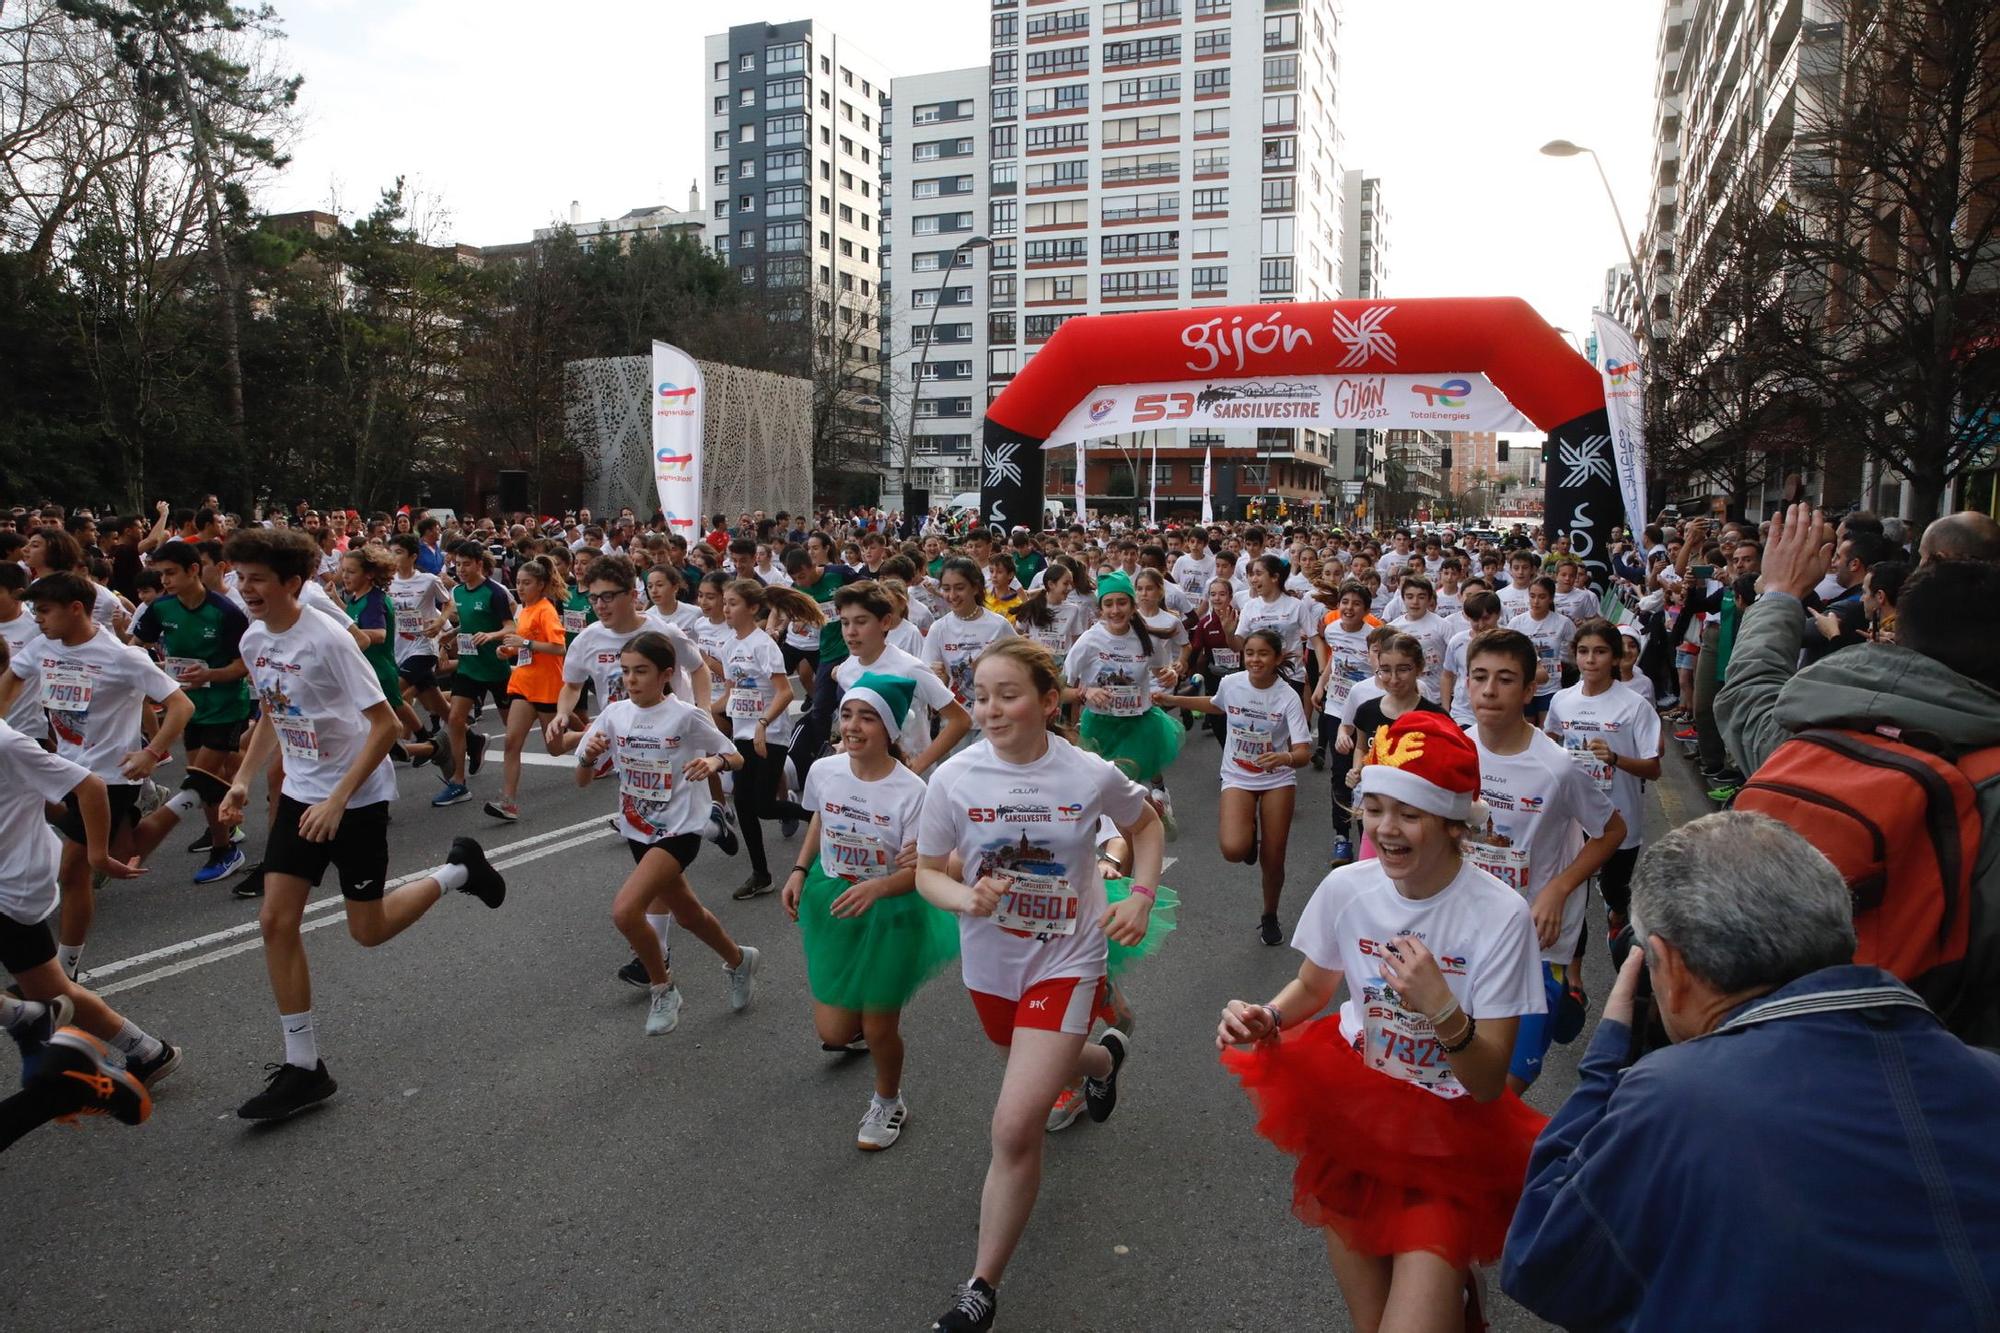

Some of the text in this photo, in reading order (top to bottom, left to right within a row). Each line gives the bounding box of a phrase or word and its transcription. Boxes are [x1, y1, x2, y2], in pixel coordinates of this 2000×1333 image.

[1181, 311, 1312, 372] gijón
[1132, 392, 1195, 423] 53
[1212, 401, 1320, 419] SANSILVESTRE
[1360, 408, 1389, 420] 2022
[1410, 411, 1470, 422] TotalEnergies
[43, 659, 56, 669] 53
[598, 654, 616, 664] 53
[49, 685, 81, 702] 7579
[732, 698, 755, 712] 7553
[1228, 705, 1241, 715] 53
[282, 728, 312, 749] 7632
[1236, 739, 1264, 755] 7473
[626, 768, 660, 790] 7502
[825, 802, 842, 815] 53
[968, 807, 996, 823] 53
[1004, 813, 1052, 823] SANSILVESTRE
[832, 843, 870, 867] 7212
[1006, 890, 1062, 919] 7650
[1368, 1006, 1394, 1021] 53
